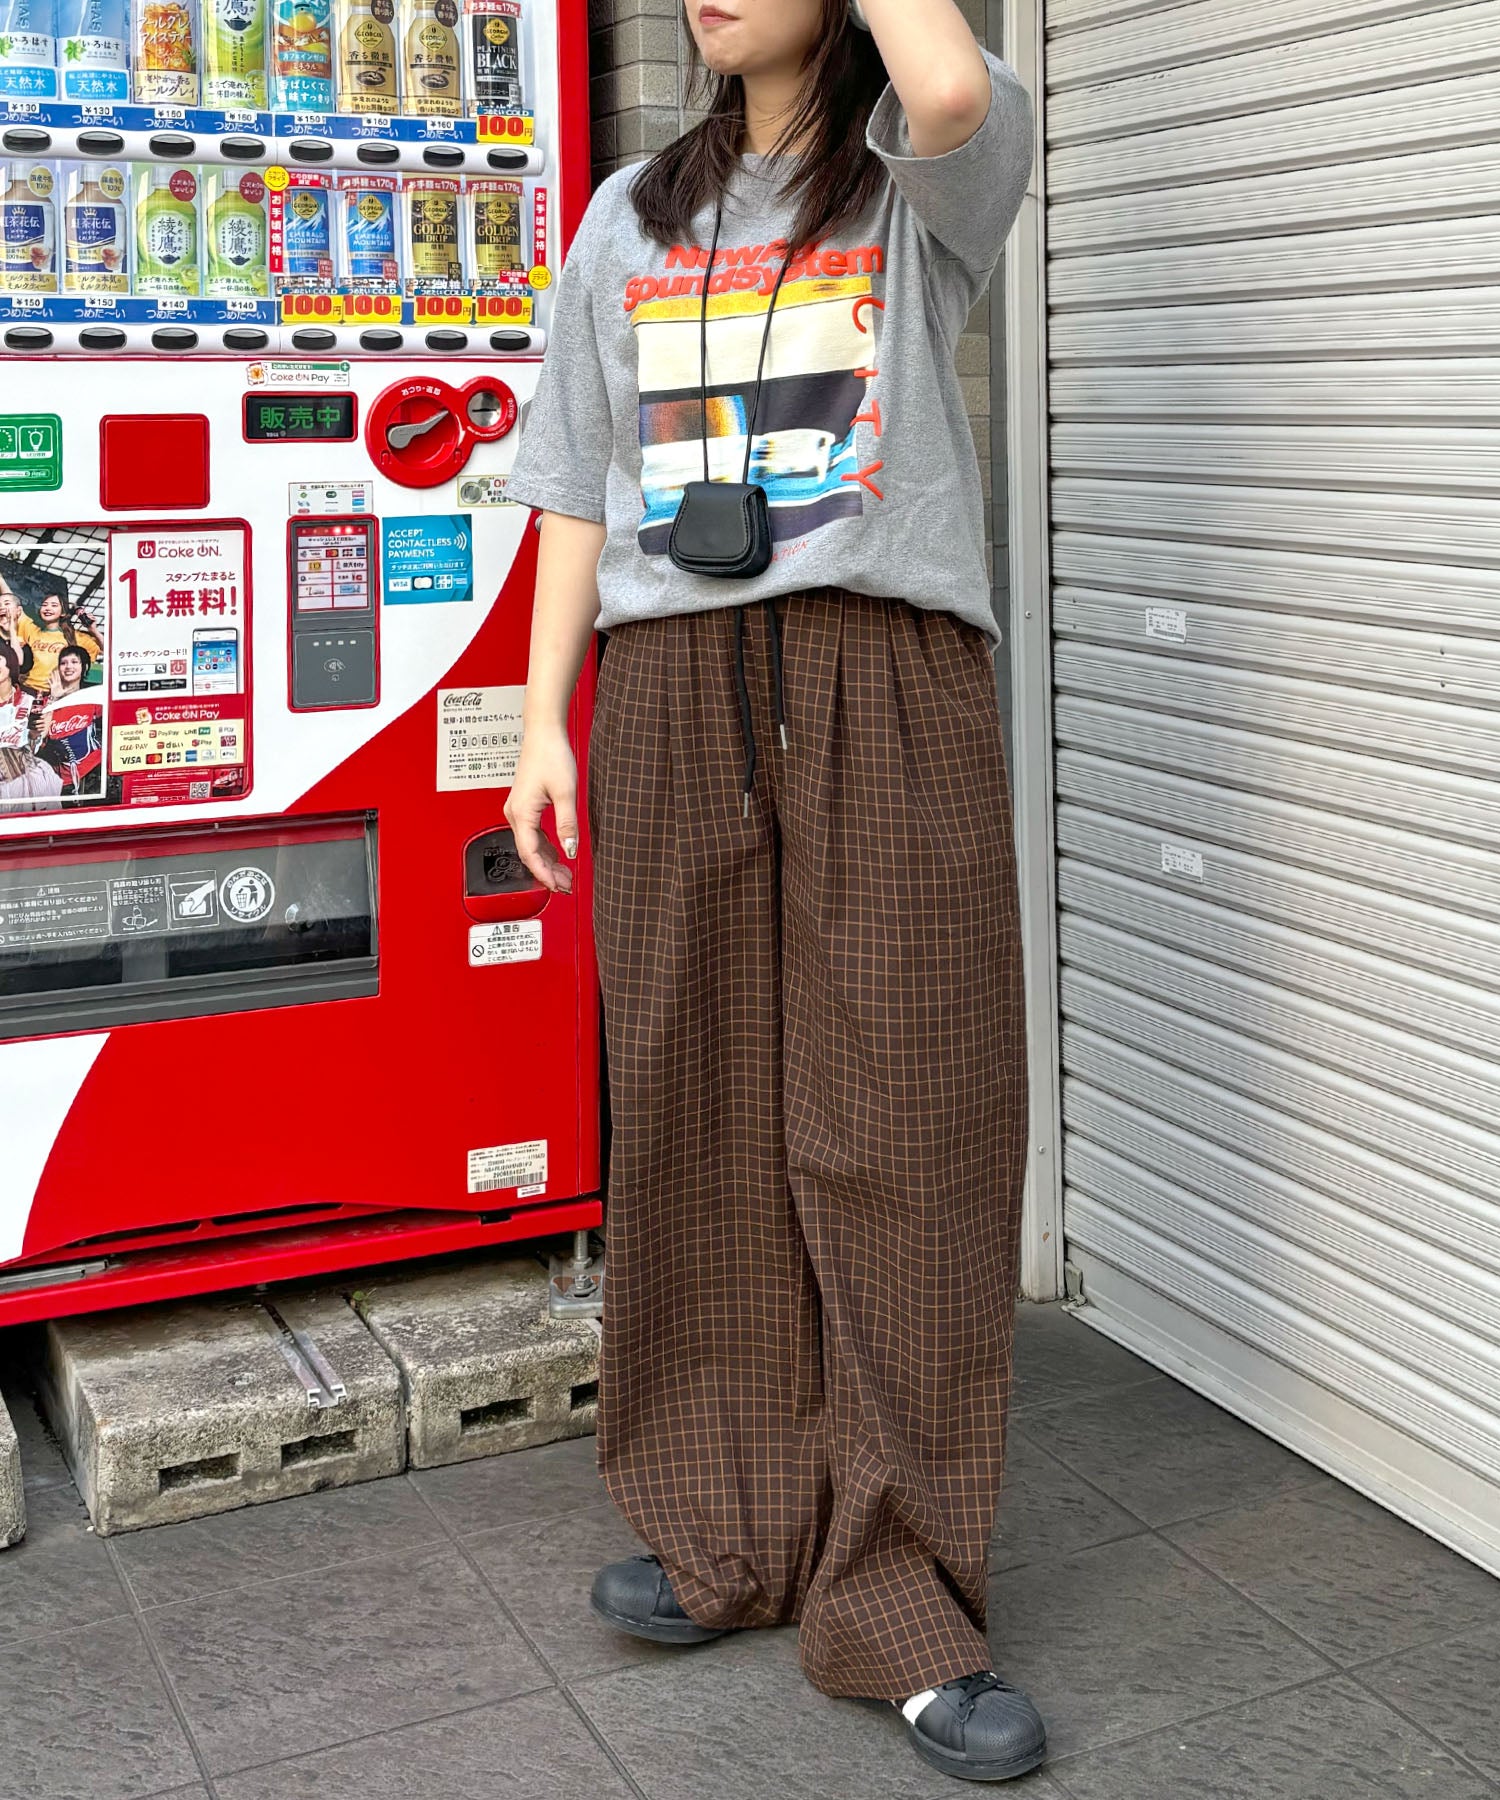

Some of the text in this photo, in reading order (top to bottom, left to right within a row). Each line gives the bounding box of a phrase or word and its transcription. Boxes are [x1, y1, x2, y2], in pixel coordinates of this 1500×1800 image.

[476, 46, 516, 54] PLATINUM
[477, 53, 517, 70] BLACK
[5, 77, 47, 89] 天然水
[77, 80, 118, 93] 天然水
[11, 103, 37, 112] ¥130
[85, 106, 110, 115] ¥130
[431, 120, 452, 128] ¥160
[158, 217, 177, 253] 綾鷹
[288, 231, 324, 239] EMERALD
[413, 224, 456, 236] GOLDEN
[477, 226, 519, 236] GOLDEN
[228, 218, 247, 254] 綾鷹
[425, 235, 448, 243] DRIP
[16, 298, 41, 307] ¥150
[88, 297, 113, 307] ¥150
[230, 301, 254, 310] ¥140
[270, 373, 294, 381] Coke
[311, 373, 329, 384] Pay
[260, 405, 341, 430] 販売中
[388, 529, 423, 538] ACCEPT
[388, 537, 452, 549] CONTACTLESS
[158, 544, 219, 558] Coke ON
[388, 549, 435, 559] PAYMENTS
[165, 571, 236, 582] スタンプたまると
[154, 712, 181, 721] Coke
[200, 709, 220, 719] Pay
[121, 756, 142, 765] VISA
